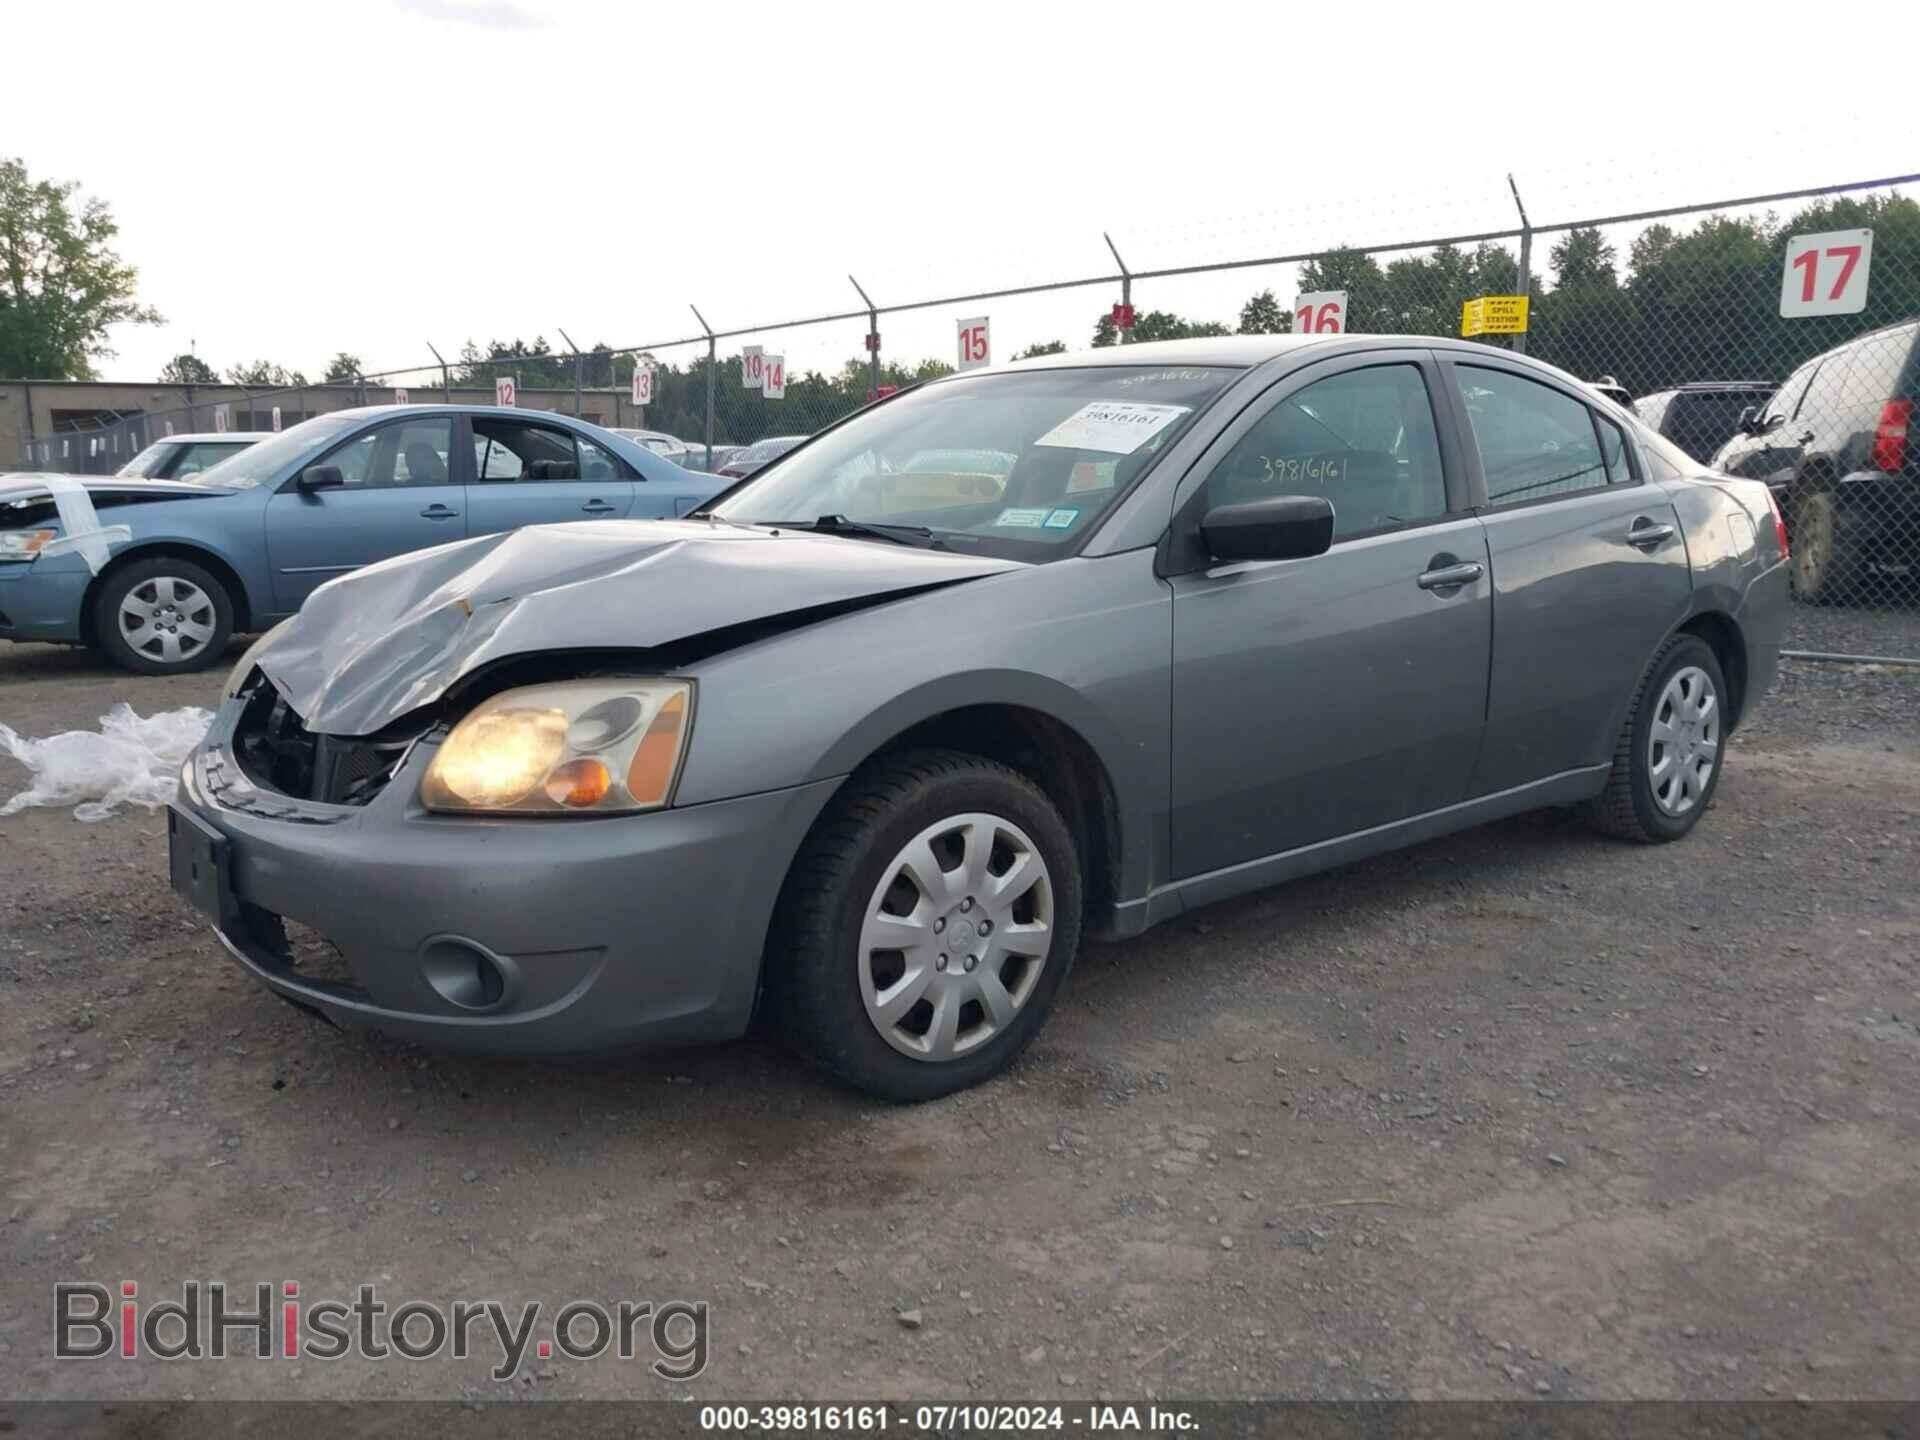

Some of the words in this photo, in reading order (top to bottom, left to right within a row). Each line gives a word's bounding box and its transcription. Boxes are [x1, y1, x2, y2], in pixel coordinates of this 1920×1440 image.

[1792, 246, 1863, 303] 17
[1296, 303, 1341, 334] 16
[1491, 306, 1515, 314] SPILL
[960, 326, 987, 361] 15
[744, 353, 761, 379] 10
[765, 363, 783, 391] 14
[497, 383, 512, 405] 12
[635, 374, 649, 399] 13
[1258, 455, 1348, 485] 39816161
